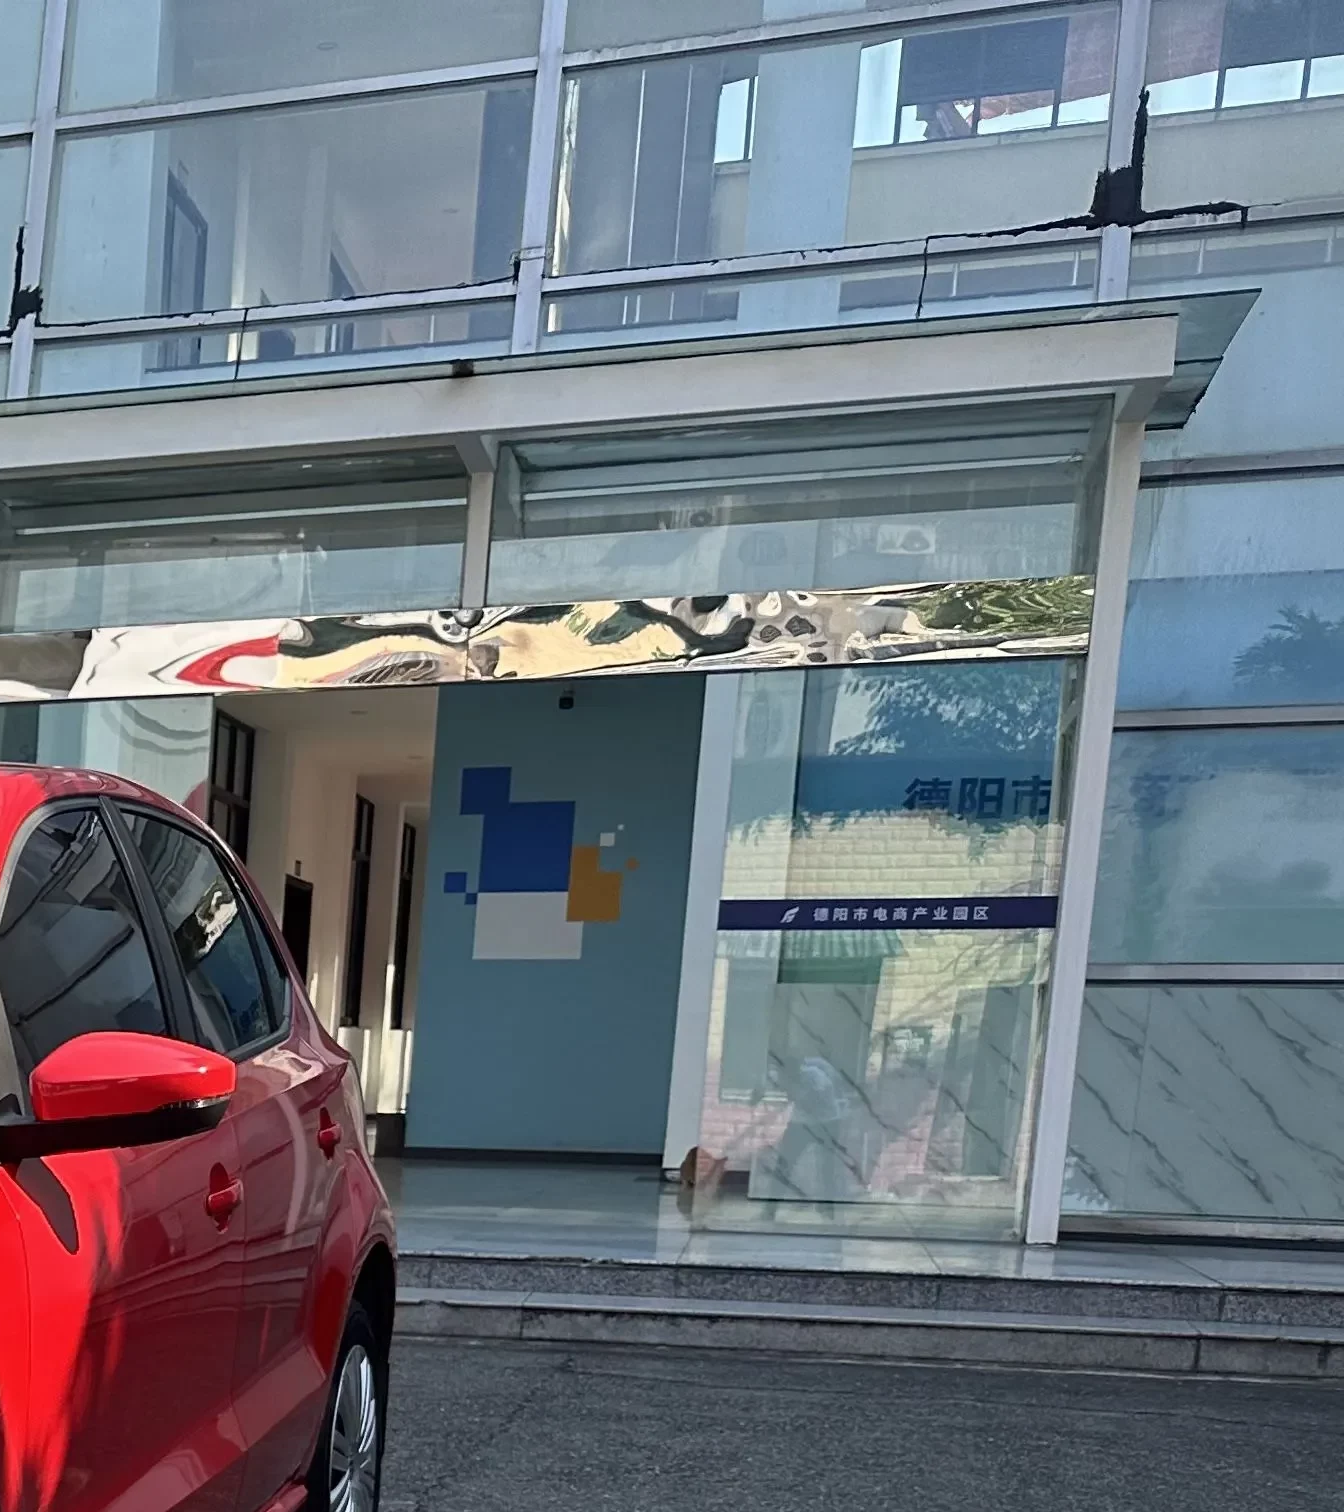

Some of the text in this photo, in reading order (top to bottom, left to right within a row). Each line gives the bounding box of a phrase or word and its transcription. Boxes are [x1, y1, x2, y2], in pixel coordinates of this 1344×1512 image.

[903, 774, 1052, 820] 德阳市
[813, 906, 989, 922] 德阳市电商产业园区
